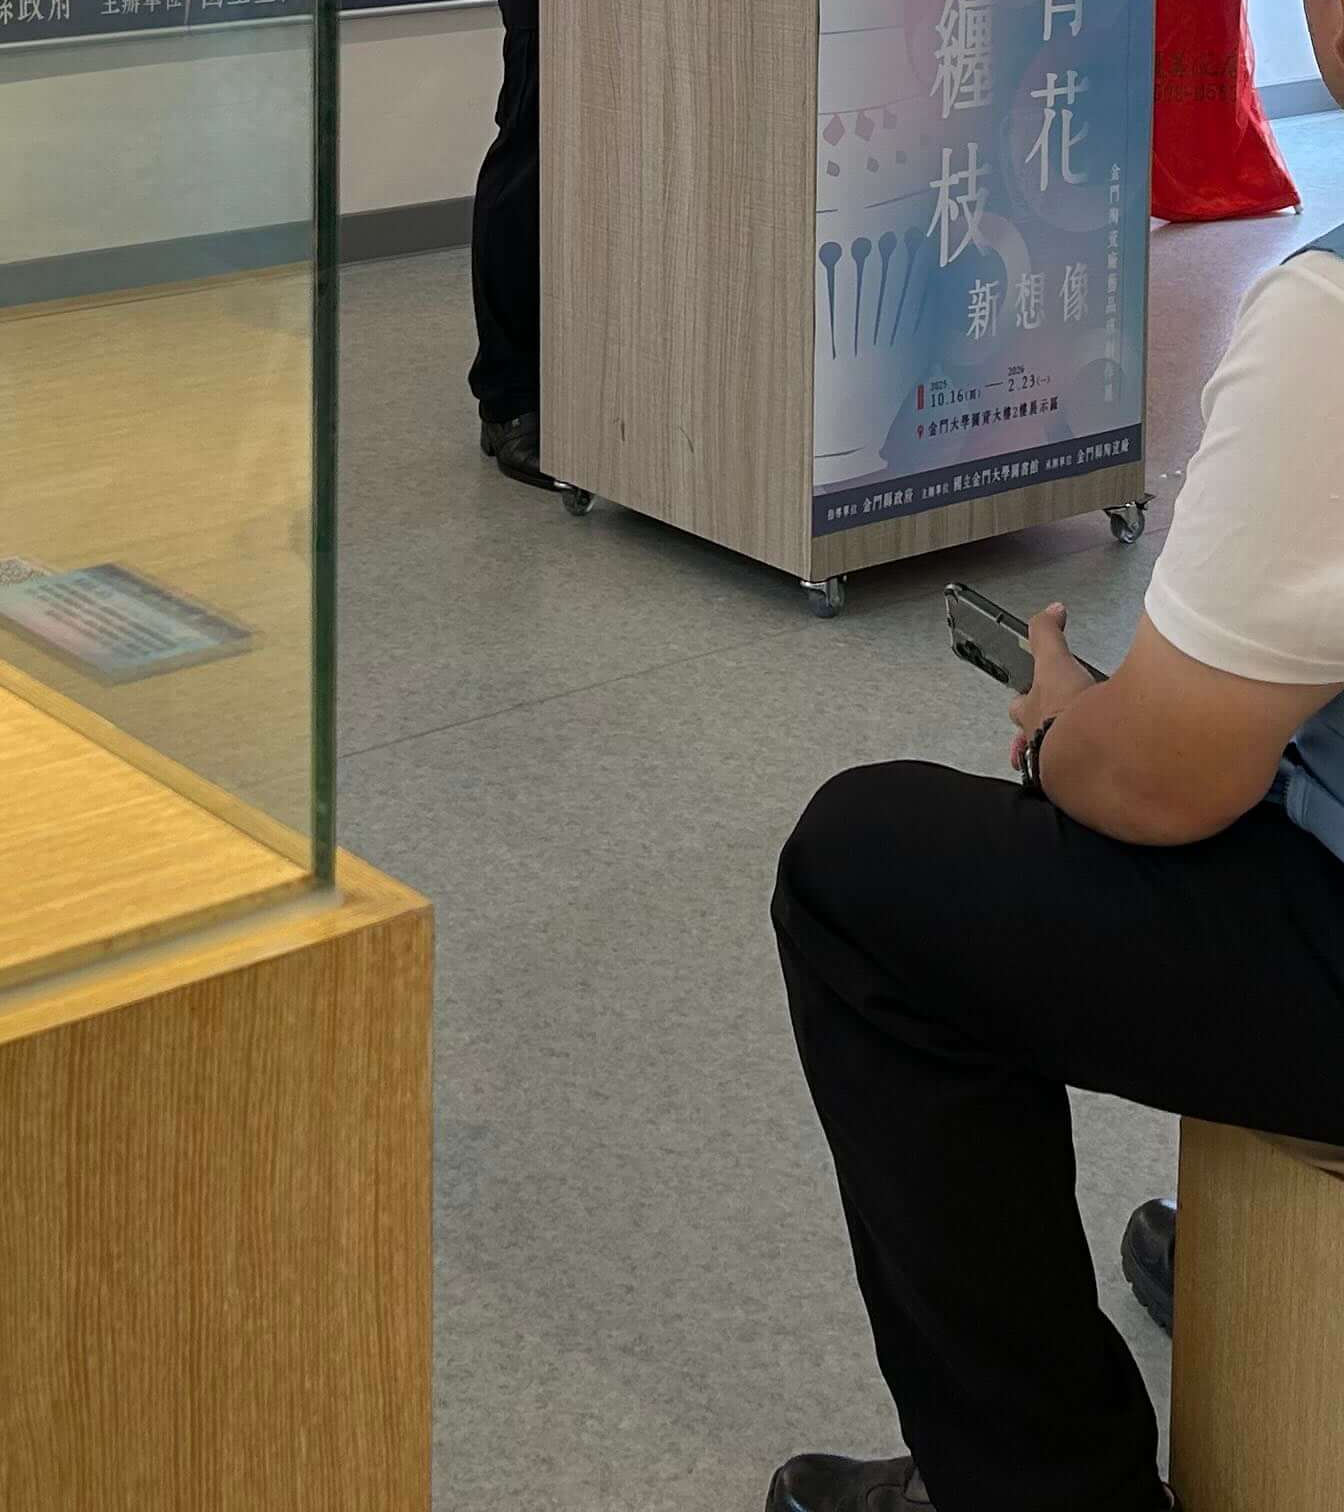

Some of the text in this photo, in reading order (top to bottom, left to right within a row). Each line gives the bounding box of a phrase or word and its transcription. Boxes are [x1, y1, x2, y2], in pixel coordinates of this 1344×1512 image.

[967, 262, 1089, 340] 新想像
[862, 488, 914, 513] 金門縣政府
